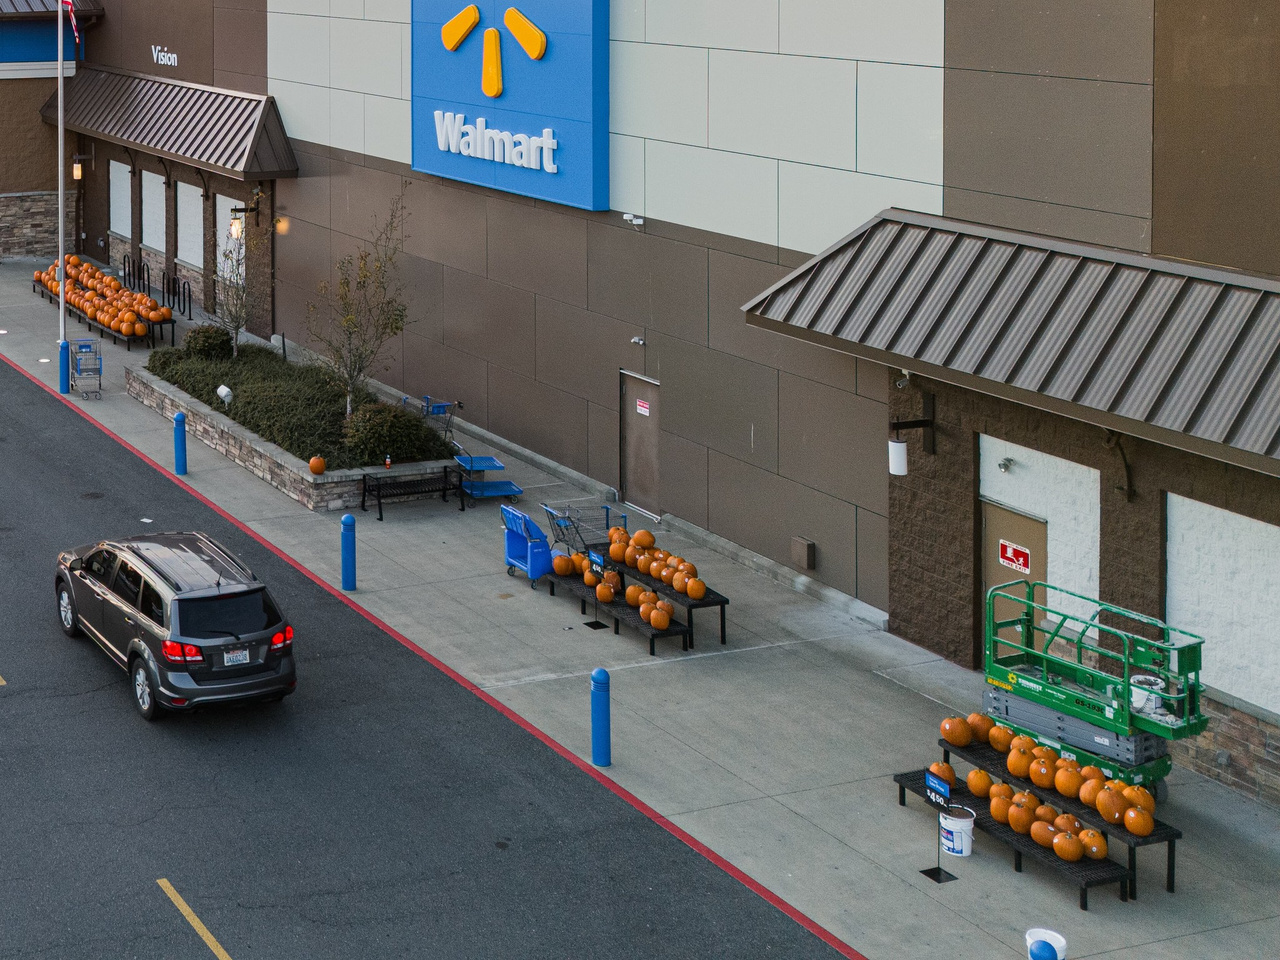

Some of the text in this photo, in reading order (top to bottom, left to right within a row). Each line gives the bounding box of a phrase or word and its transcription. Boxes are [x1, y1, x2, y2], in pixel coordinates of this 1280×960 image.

[151, 45, 178, 67] Vision
[433, 110, 558, 173] Walmart
[1002, 560, 1027, 573] FIRE EXIT
